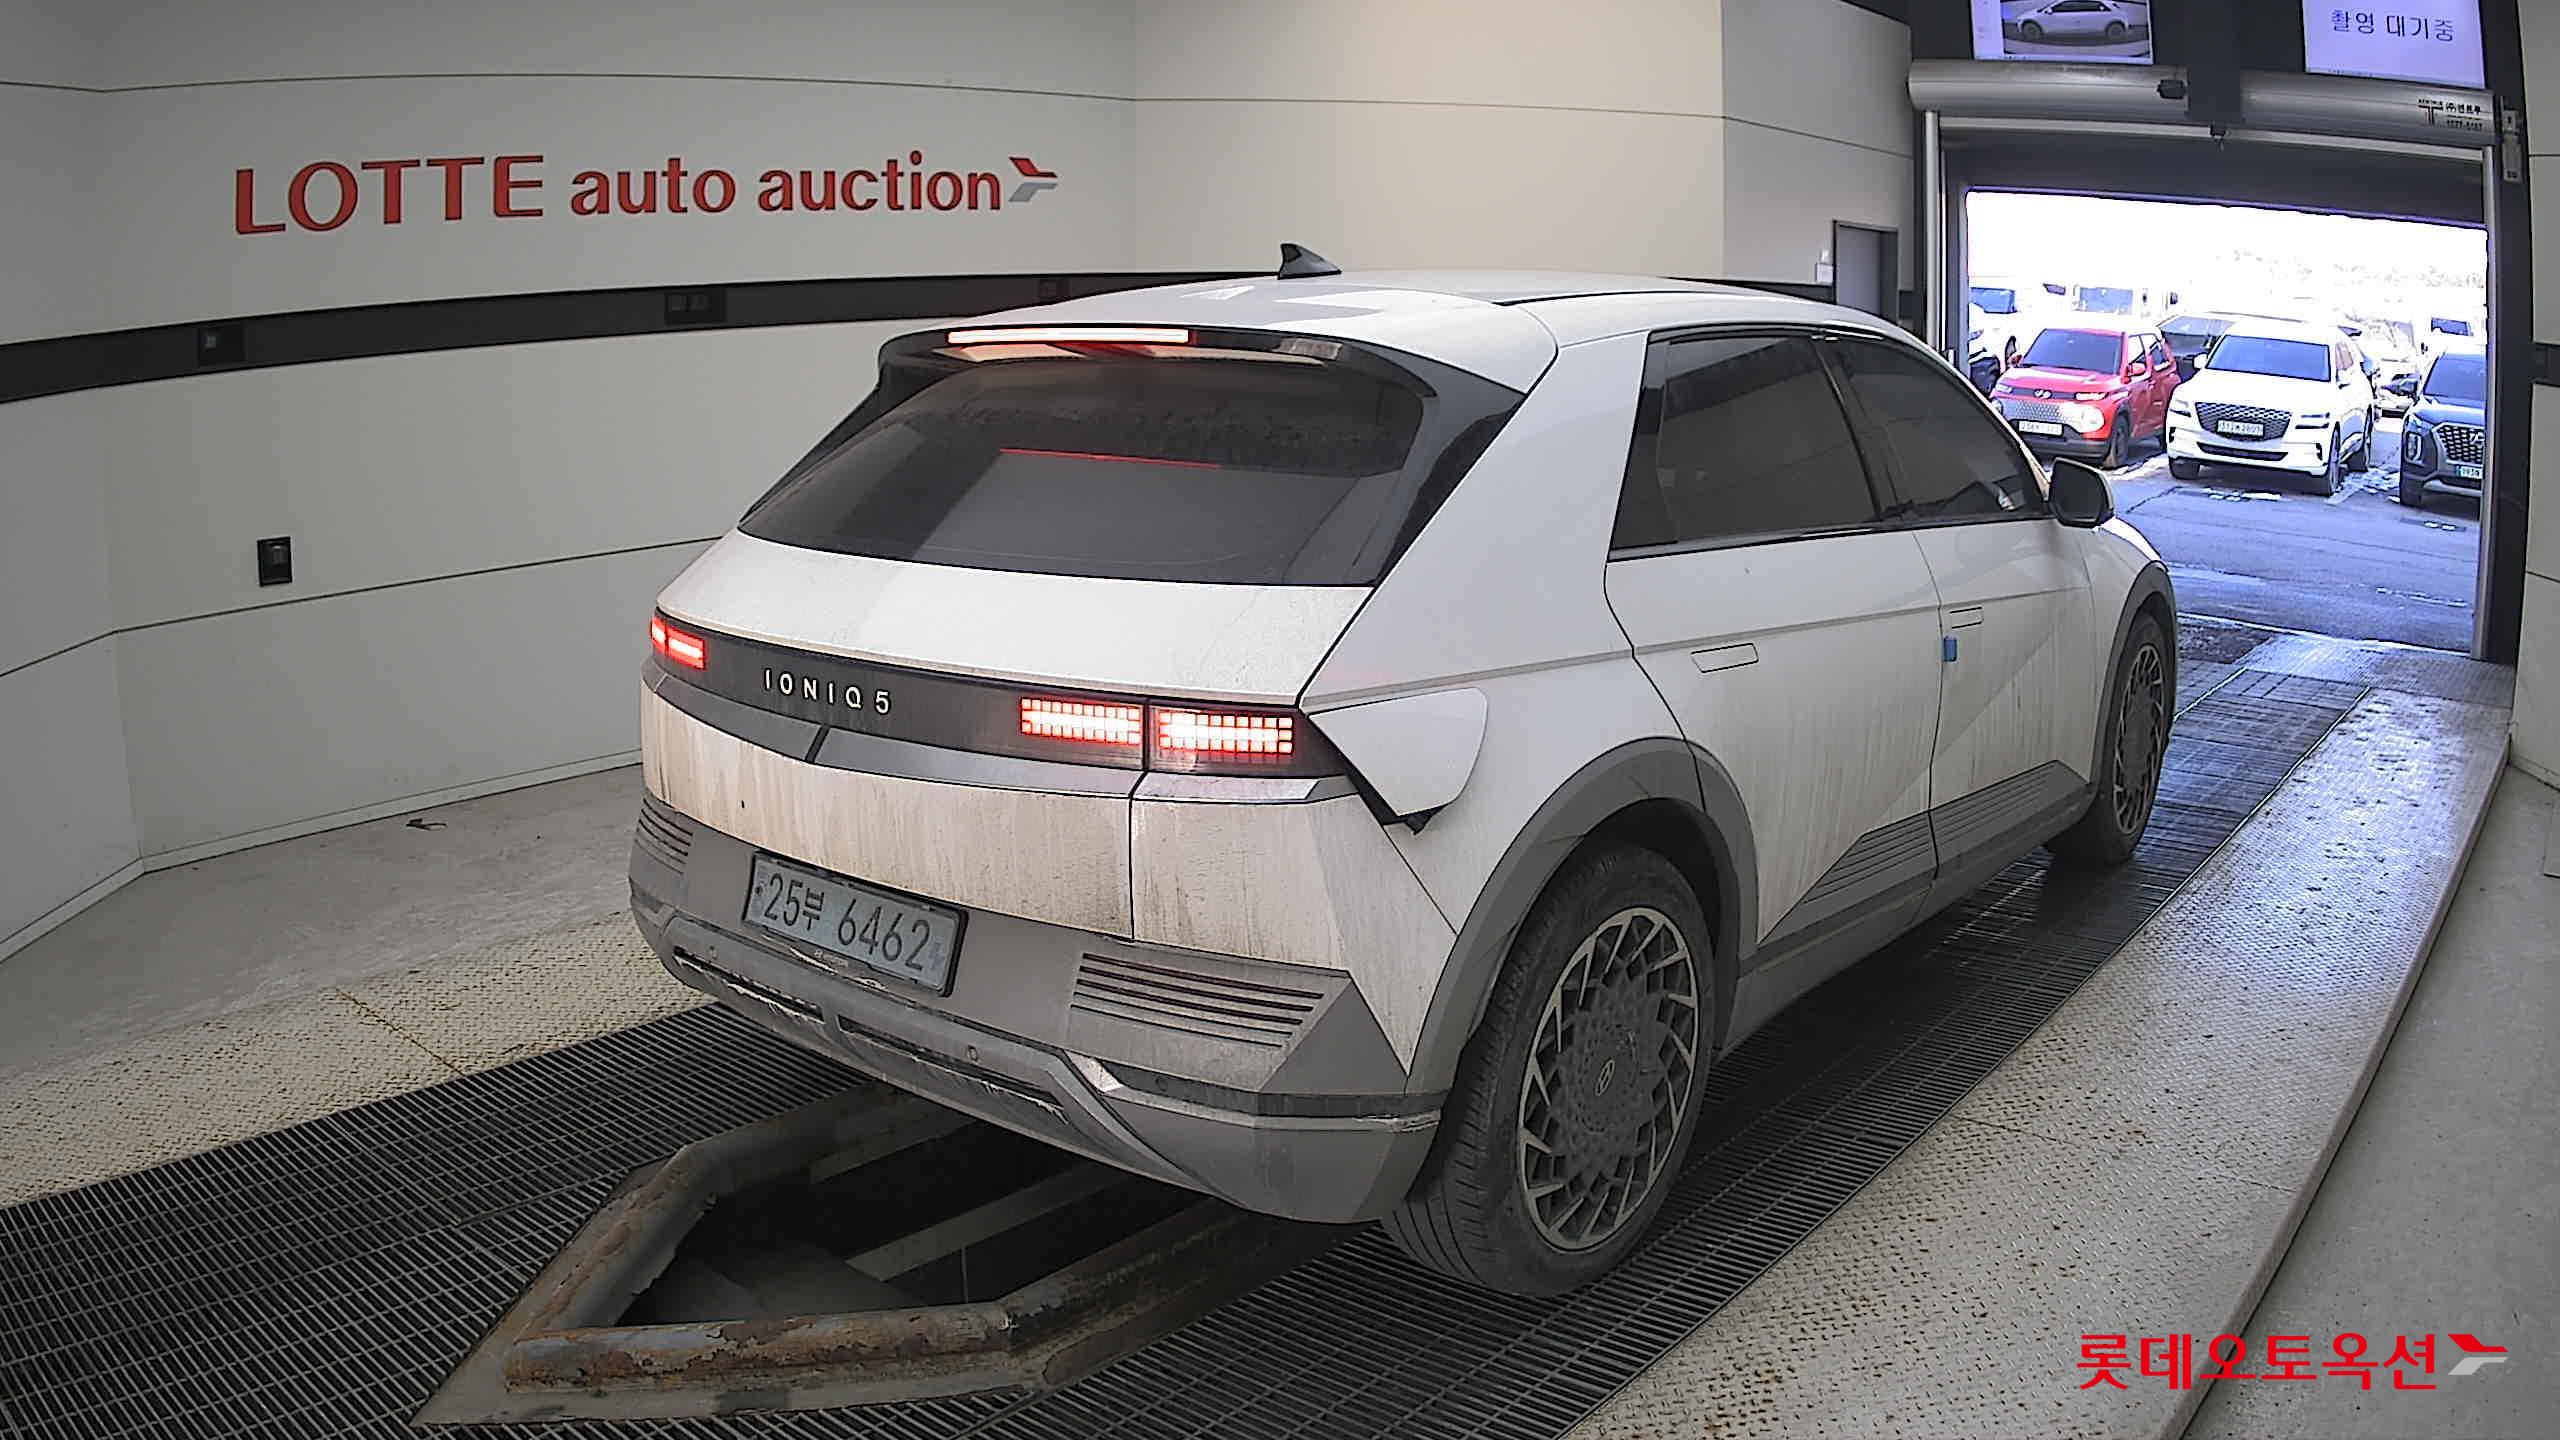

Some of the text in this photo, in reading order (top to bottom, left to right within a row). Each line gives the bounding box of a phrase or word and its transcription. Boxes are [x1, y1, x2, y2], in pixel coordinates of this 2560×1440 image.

[2331, 9, 2454, 42] 촬영 대기중
[235, 150, 1002, 235] LOTTE auto auction
[764, 669, 890, 714] IONIQ 5
[764, 873, 931, 971] 25부 6462
